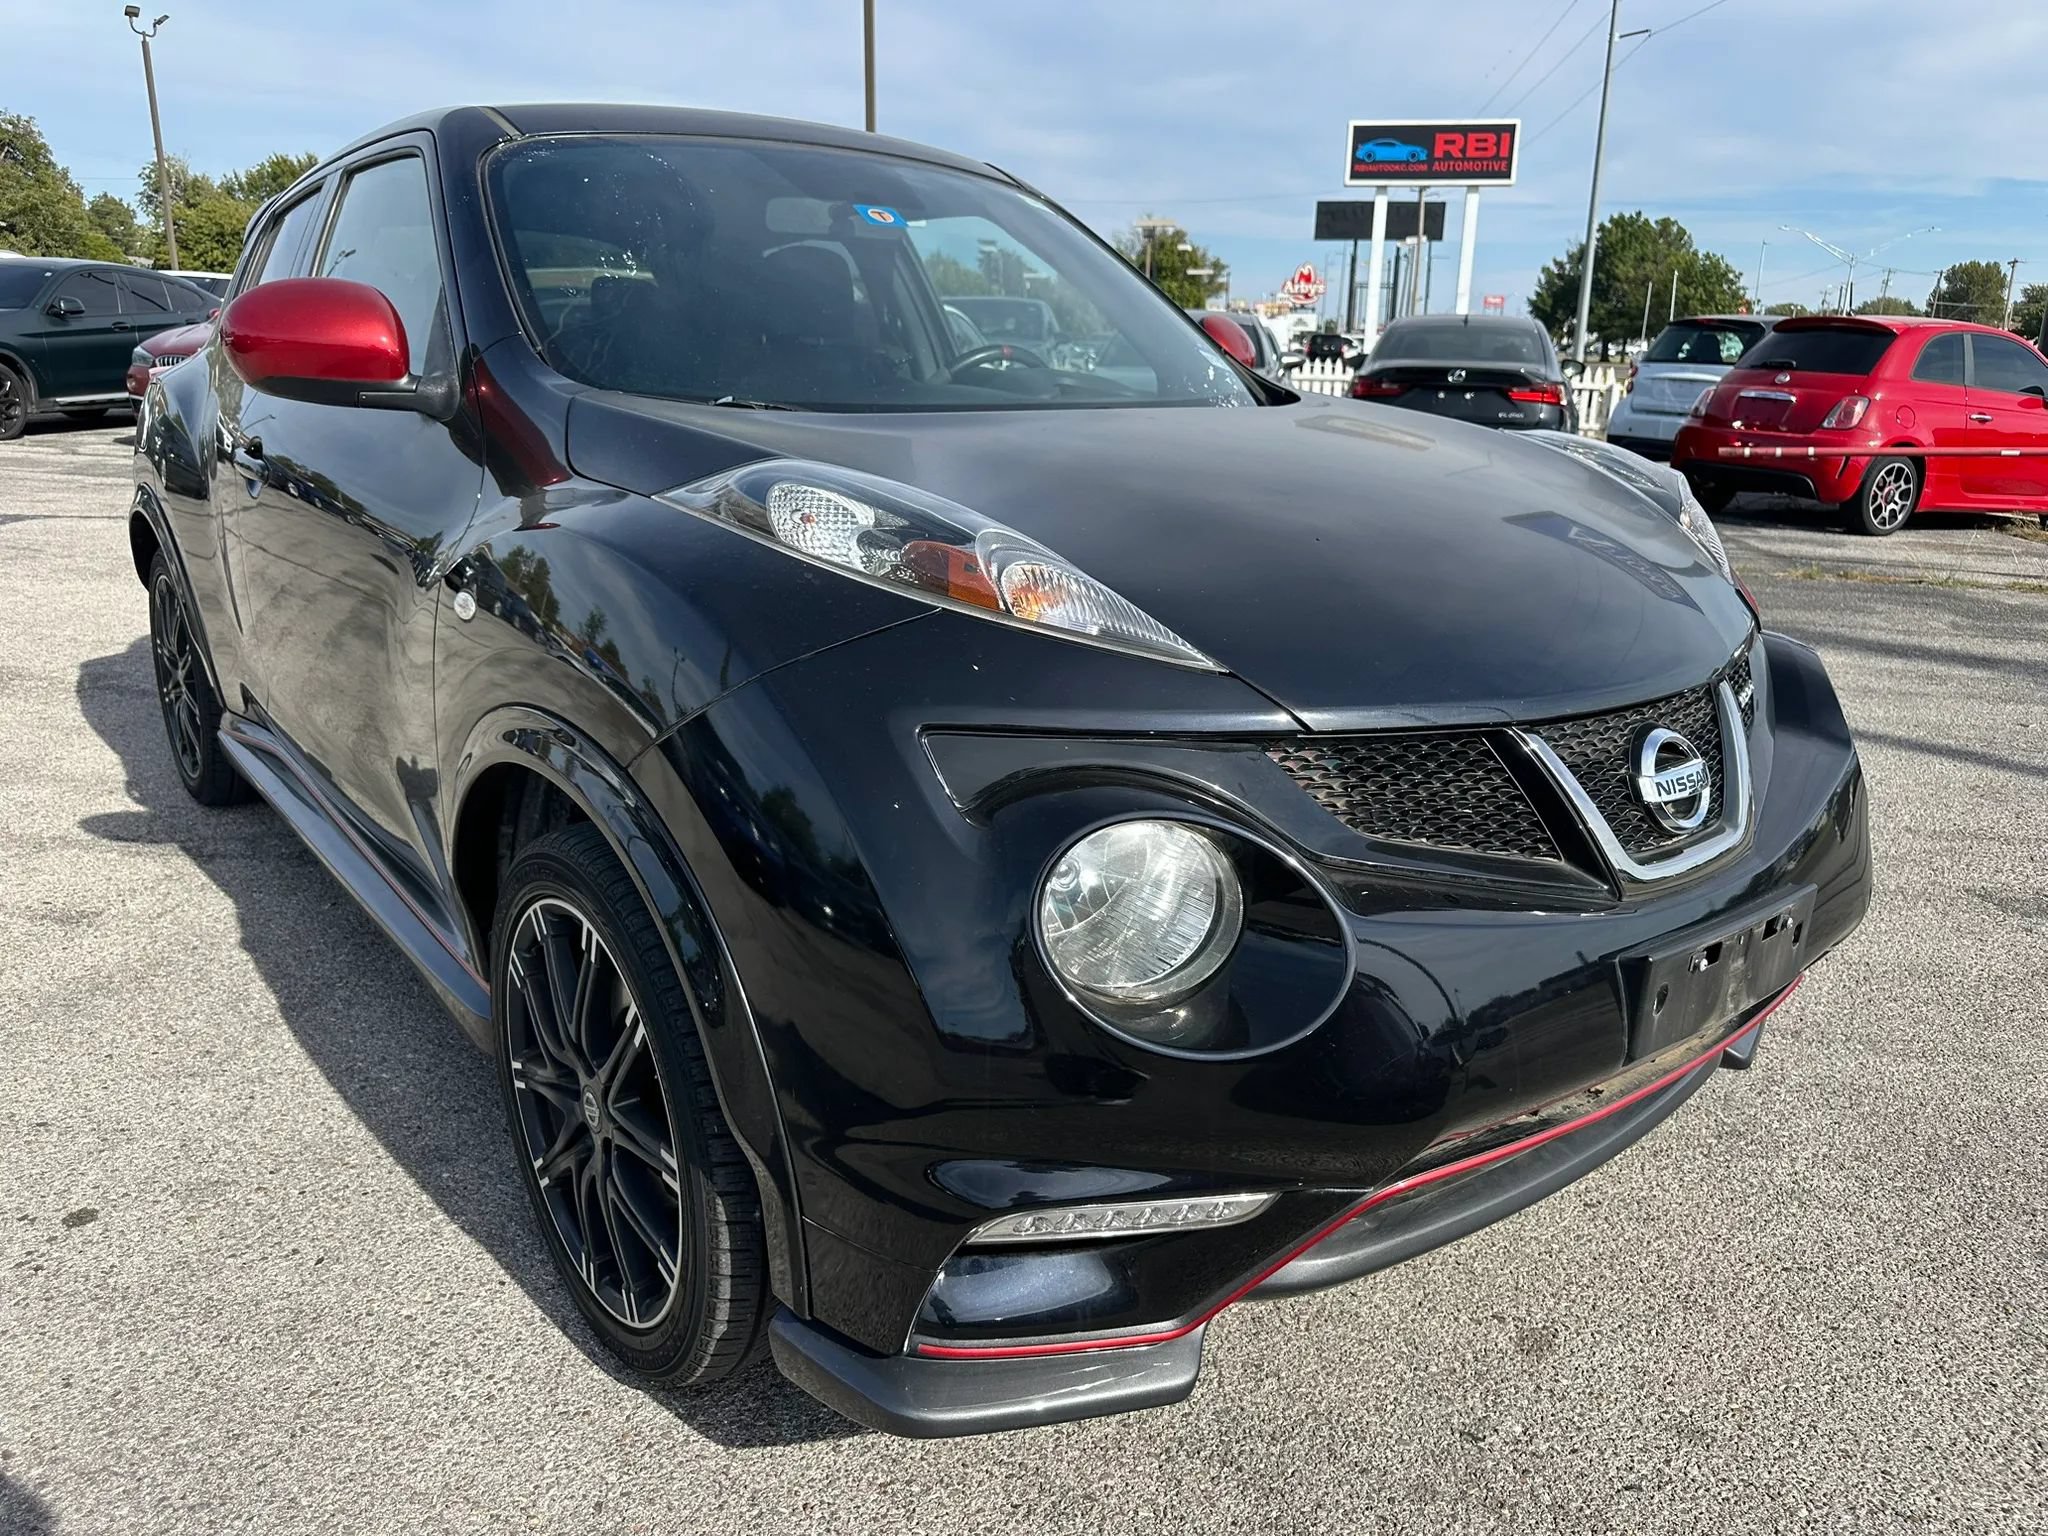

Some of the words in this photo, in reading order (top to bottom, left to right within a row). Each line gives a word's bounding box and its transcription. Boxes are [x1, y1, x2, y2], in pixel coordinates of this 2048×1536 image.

[1434, 133, 1510, 158] RBI
[1432, 160, 1508, 172] AUTOMOTIVE
[1284, 279, 1326, 296] Arby's
[1655, 768, 1708, 797] NISSAN
